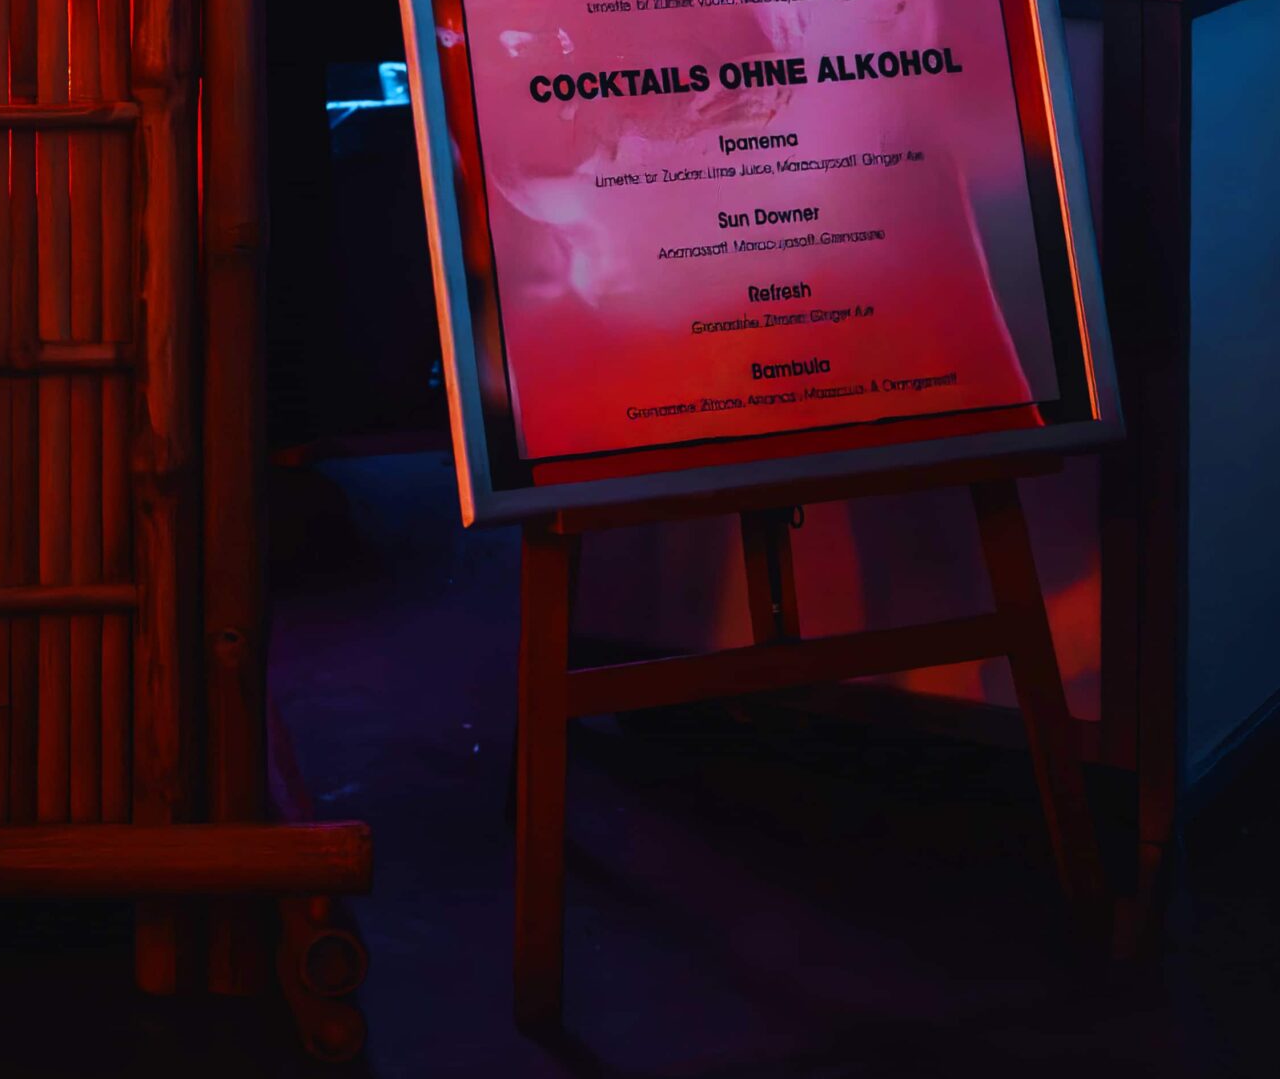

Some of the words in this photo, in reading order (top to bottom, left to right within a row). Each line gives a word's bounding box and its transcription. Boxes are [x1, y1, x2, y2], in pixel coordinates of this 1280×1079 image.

[529, 65, 710, 103] COCKTAILS
[718, 58, 808, 90] OHNE
[817, 47, 963, 83] ALKOHOL
[719, 132, 799, 155] Ipanema
[717, 211, 750, 229] Sun
[754, 206, 820, 226] Downer
[748, 281, 812, 302] Refresh
[751, 356, 831, 380] Bambula
